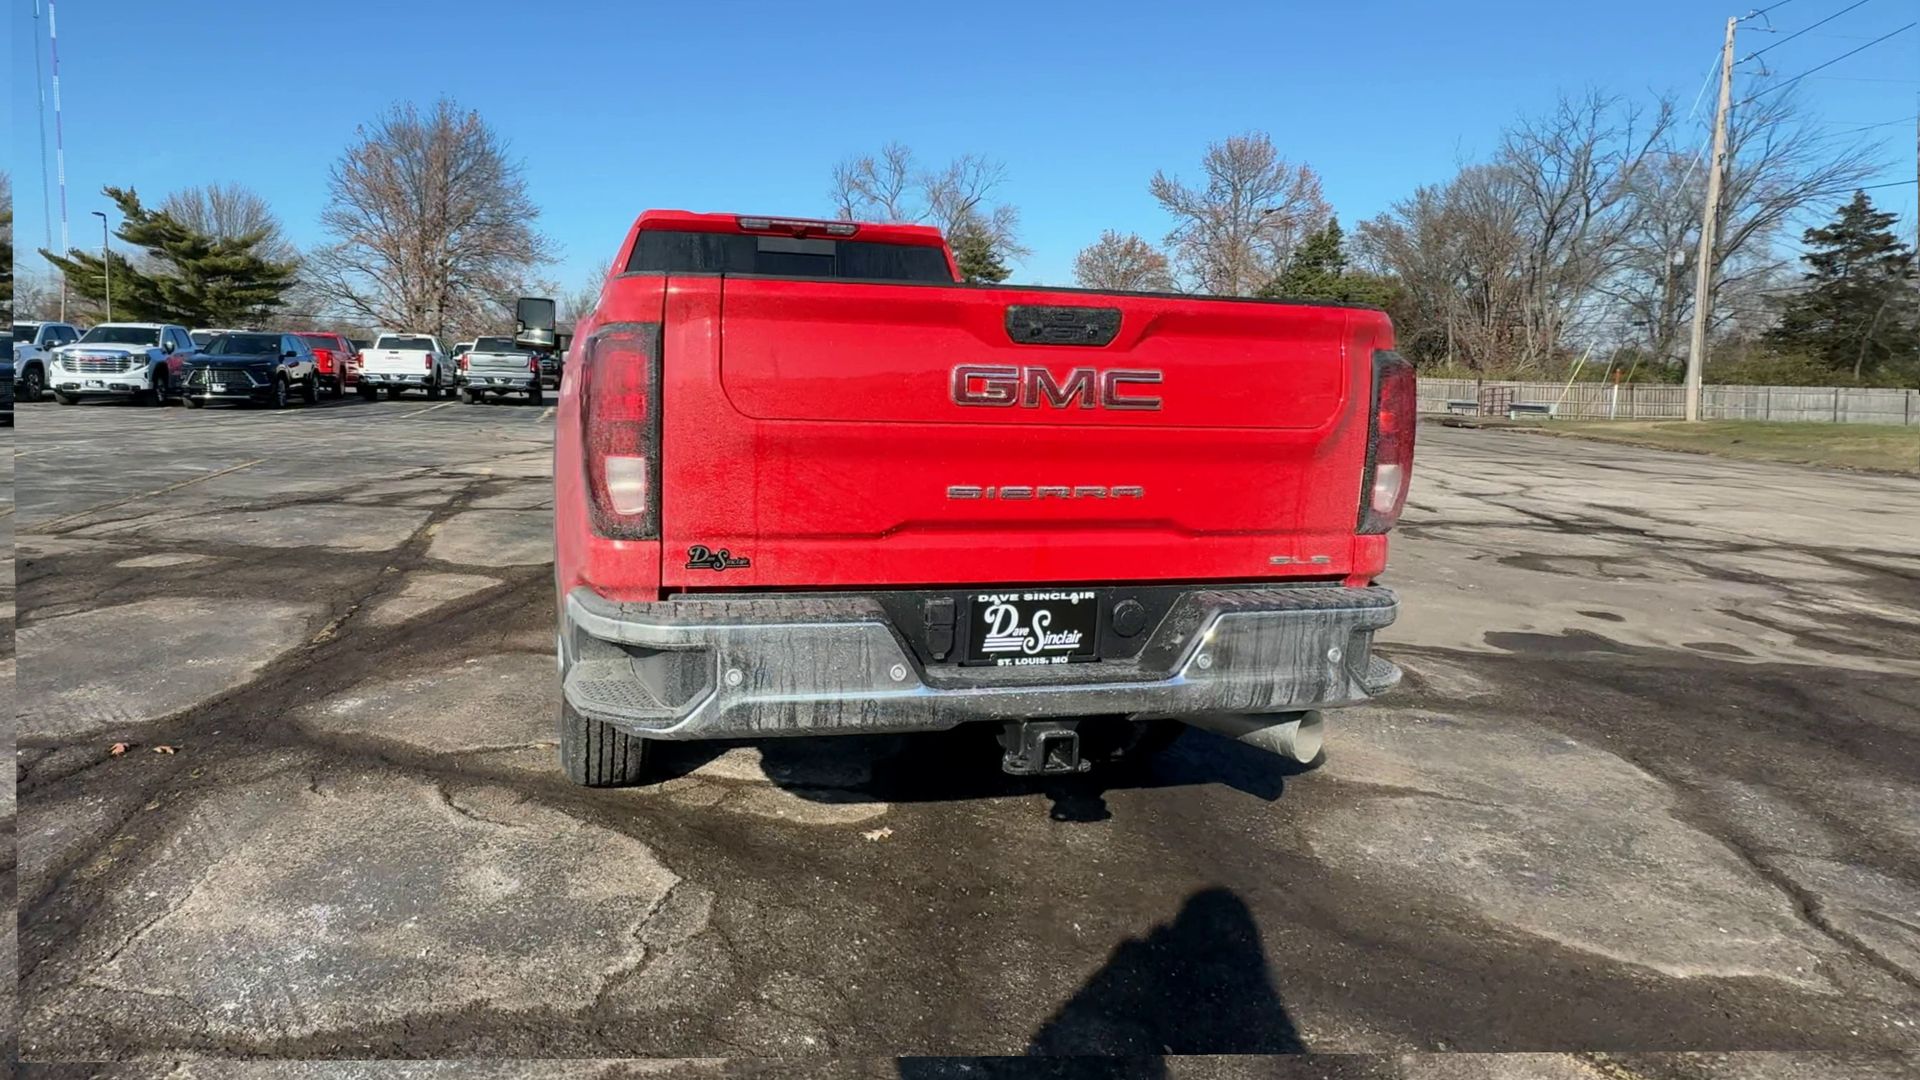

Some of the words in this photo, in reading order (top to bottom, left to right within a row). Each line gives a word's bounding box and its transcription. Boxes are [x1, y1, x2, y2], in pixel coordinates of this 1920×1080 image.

[952, 363, 1163, 411] GMC
[946, 485, 1145, 499] SIERRA
[978, 594, 1019, 602] DAVE
[1023, 592, 1095, 601] SINCLAIR
[984, 604, 1029, 637] Dave
[1023, 610, 1083, 654] Sinclair
[997, 658, 1012, 667] ST.
[1052, 656, 1068, 665] MO
